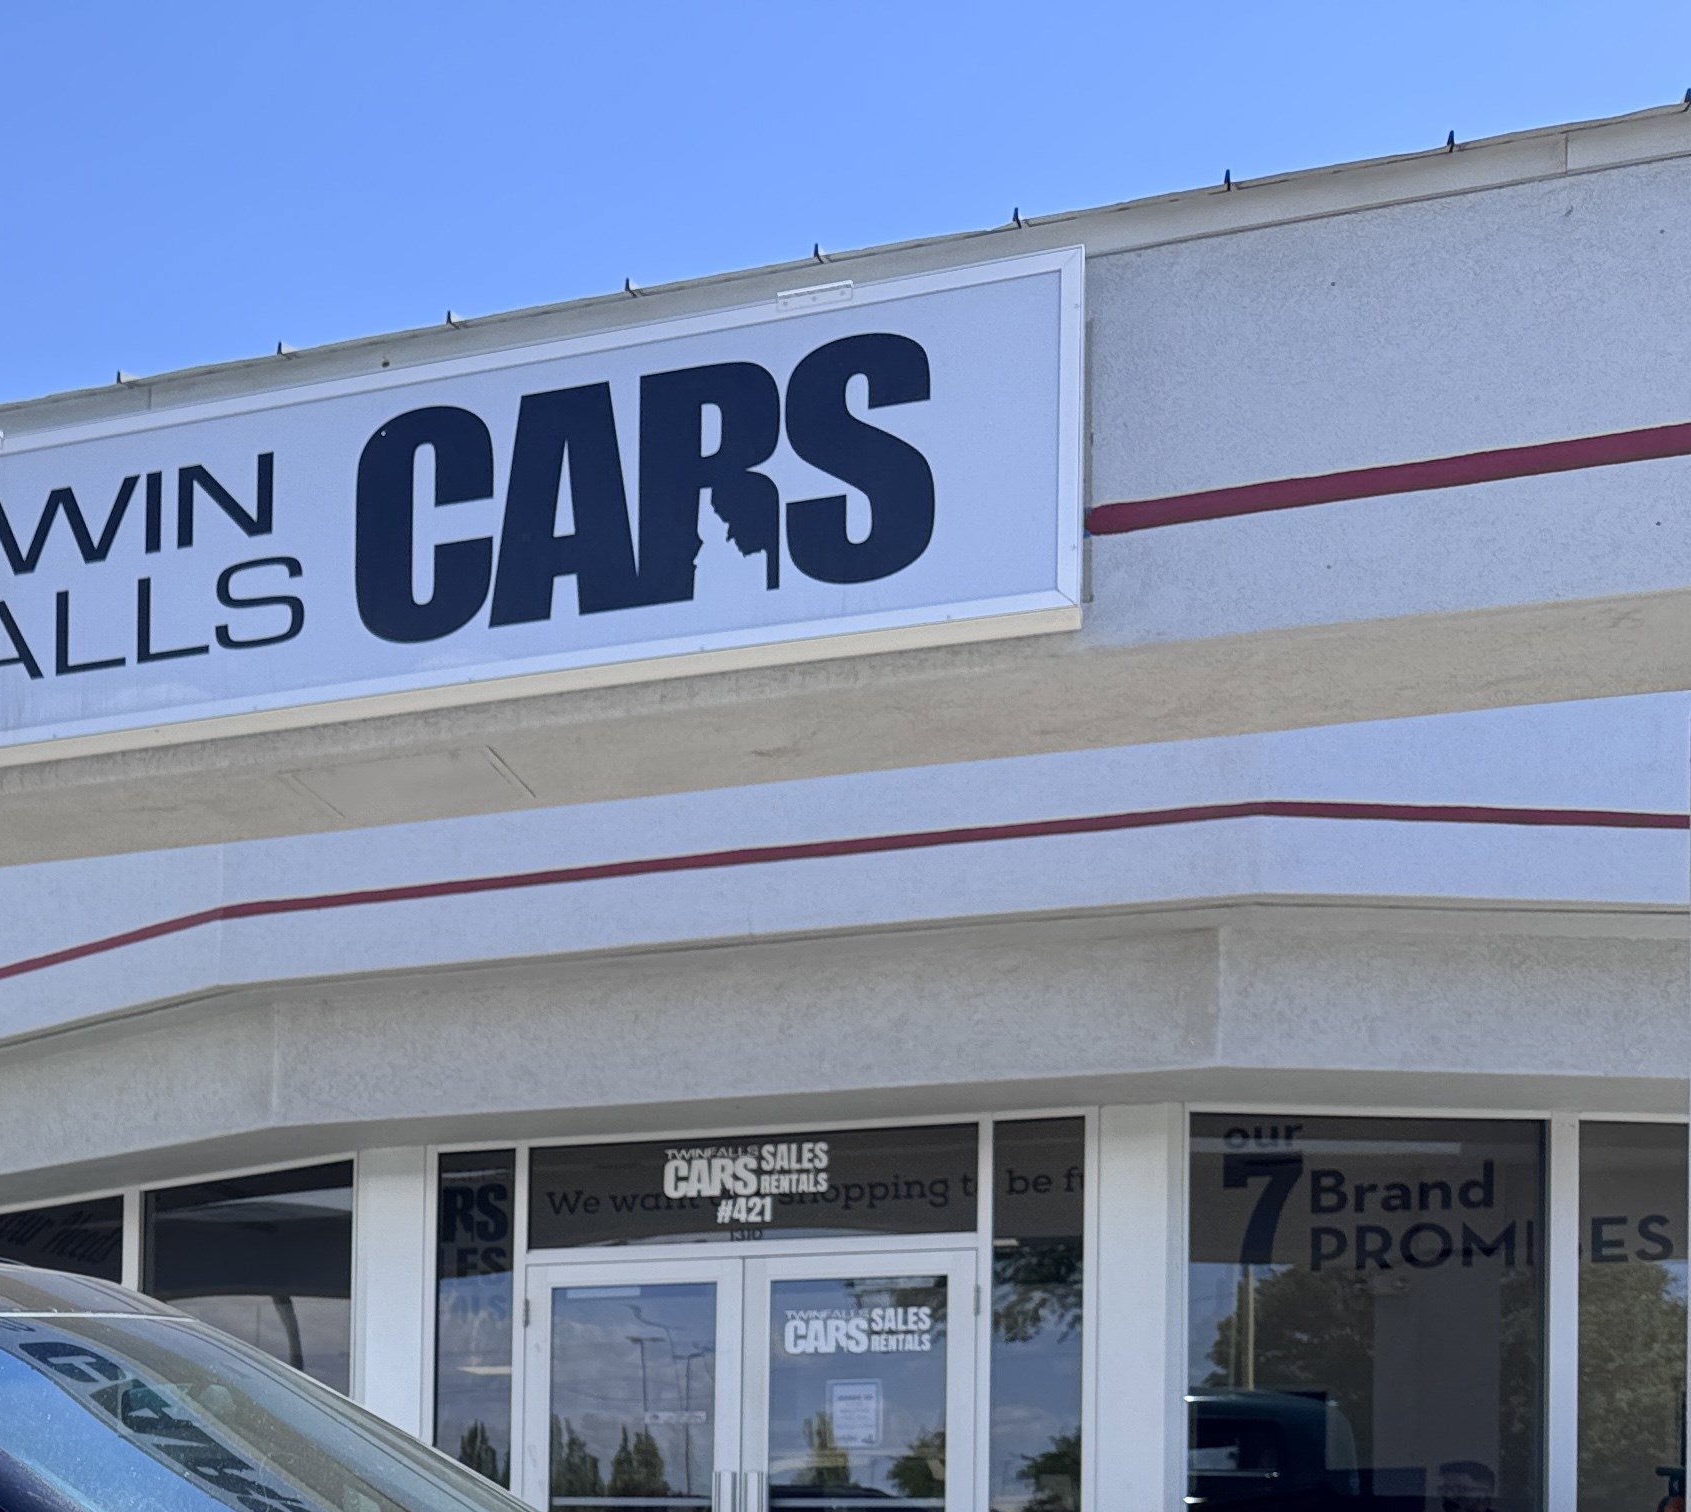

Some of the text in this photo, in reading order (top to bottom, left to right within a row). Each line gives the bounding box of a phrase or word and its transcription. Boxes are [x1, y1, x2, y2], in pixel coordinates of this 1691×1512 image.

[355, 333, 936, 643] CARS
[1223, 1122, 1303, 1150] our
[760, 1141, 829, 1171] SALES
[546, 1190, 600, 1215] We
[1008, 1169, 1053, 1195] be
[663, 1157, 758, 1199] CARS
[760, 1172, 829, 1194] RENTALS
[1309, 1158, 1495, 1215] Brand
[716, 1196, 773, 1224] #421
[1223, 1152, 1303, 1265] 7
[1309, 1214, 1675, 1272] PROMIES
[784, 1317, 869, 1354] CARS
[870, 1306, 932, 1331] SALES
[870, 1333, 932, 1352] RENTALS
